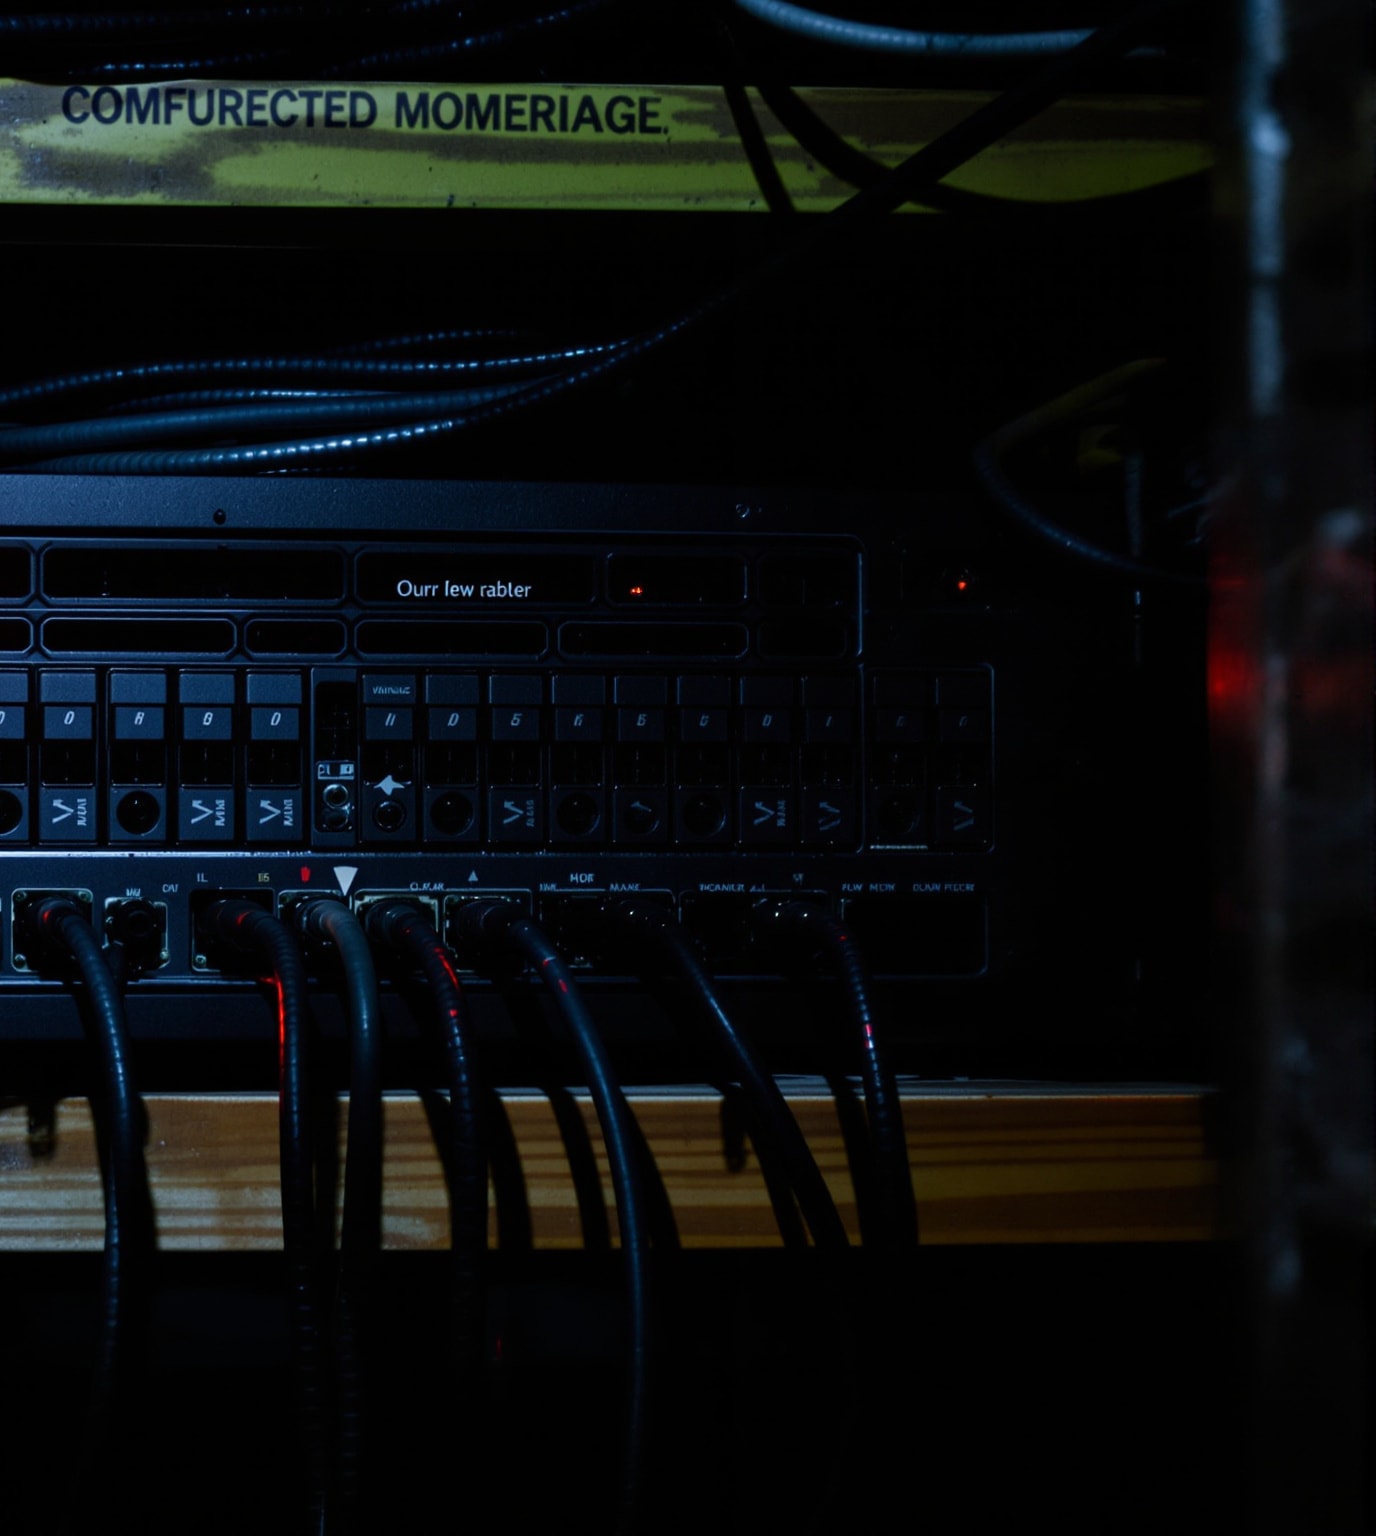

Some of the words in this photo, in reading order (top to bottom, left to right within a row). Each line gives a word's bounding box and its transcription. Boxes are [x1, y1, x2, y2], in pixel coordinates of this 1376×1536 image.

[61, 85, 378, 129] COMFURECTED
[396, 579, 439, 598] Ourr
[479, 579, 532, 598] rabler
